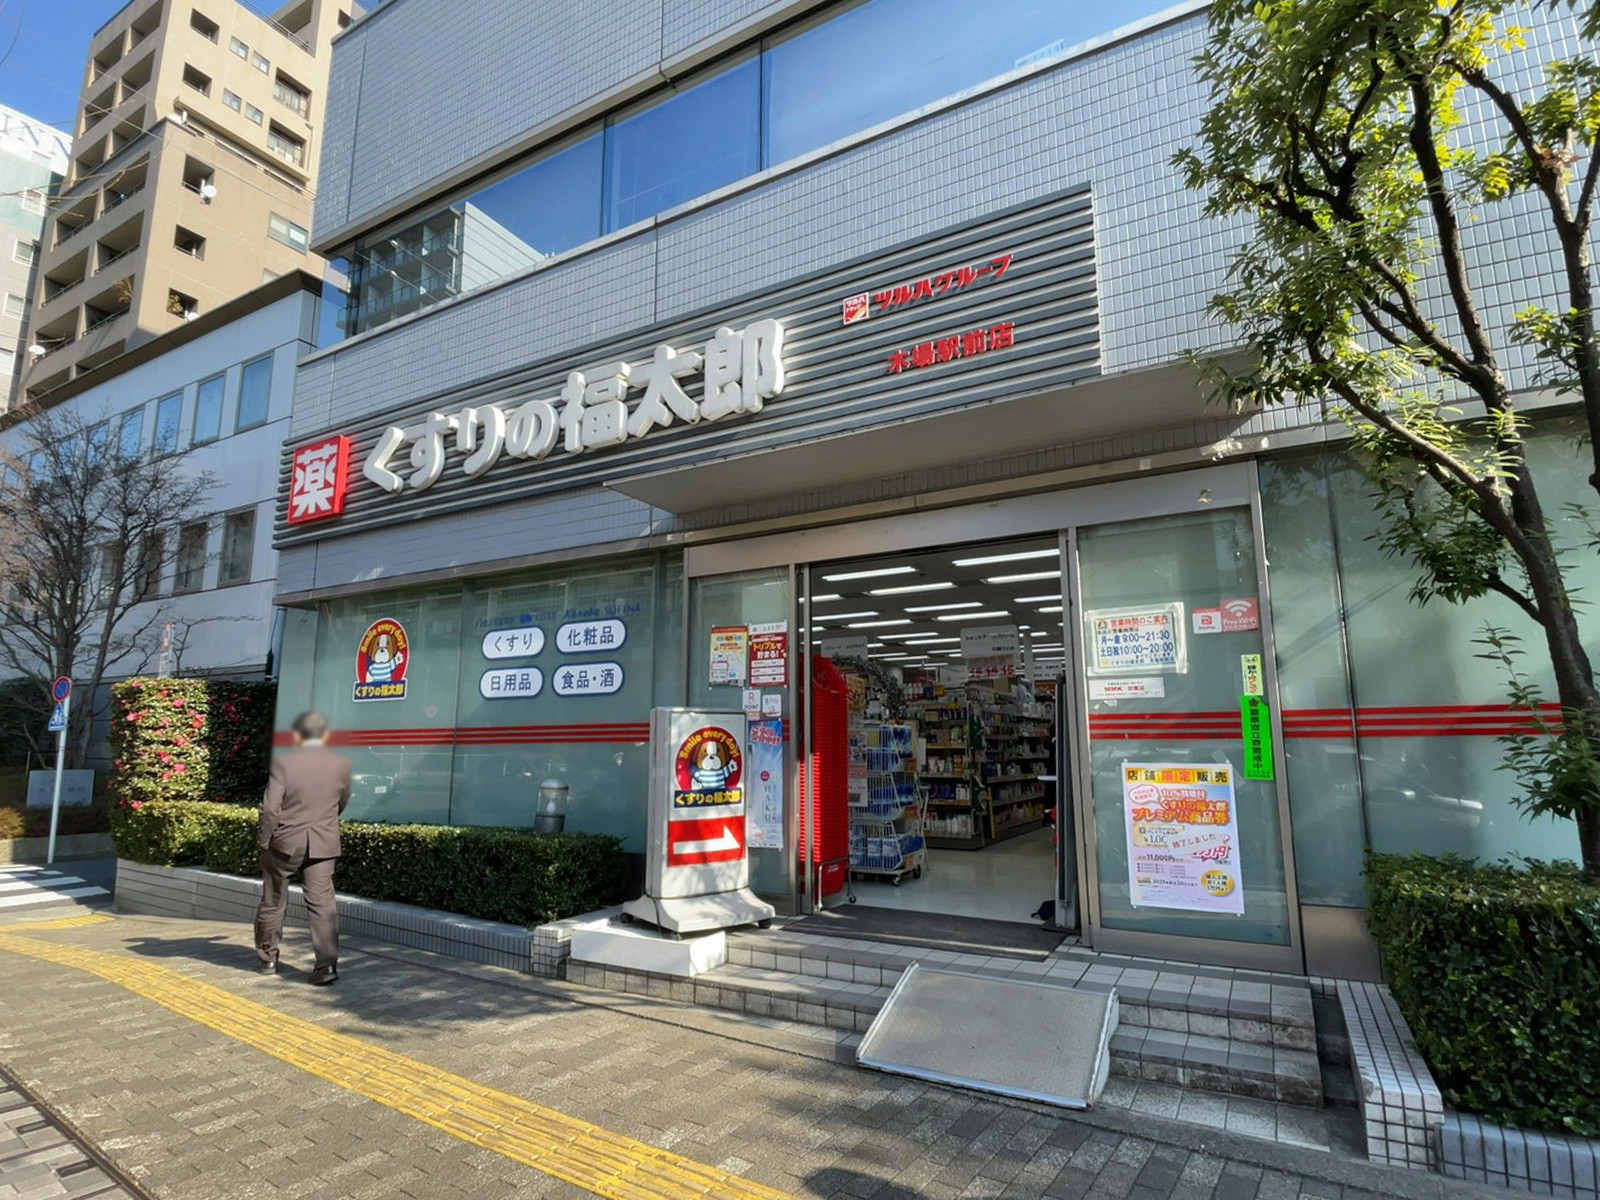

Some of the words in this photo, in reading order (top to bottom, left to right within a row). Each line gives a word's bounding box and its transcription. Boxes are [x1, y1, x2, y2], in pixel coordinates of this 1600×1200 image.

[874, 254, 1014, 311] ツルハグループ
[886, 322, 1015, 373] 木場駅前店
[363, 318, 784, 494] くすりの福太郎
[294, 444, 337, 518] 薬
[493, 632, 533, 652] くすり
[567, 628, 614, 647] 化粧品
[490, 673, 531, 692] 日用品
[561, 668, 614, 689] 食品・酒
[355, 684, 404, 697] くすりの福太郎
[680, 734, 702, 759] Smile
[703, 730, 727, 742] every
[726, 738, 740, 758] day!
[1127, 769, 1228, 783] 店舗限定販売
[675, 790, 741, 805] くすりの福太郎
[1161, 799, 1227, 811] くすりの福太郎
[1133, 808, 1227, 824] プレミアム商品券
[1173, 833, 1216, 848] 終了しました
